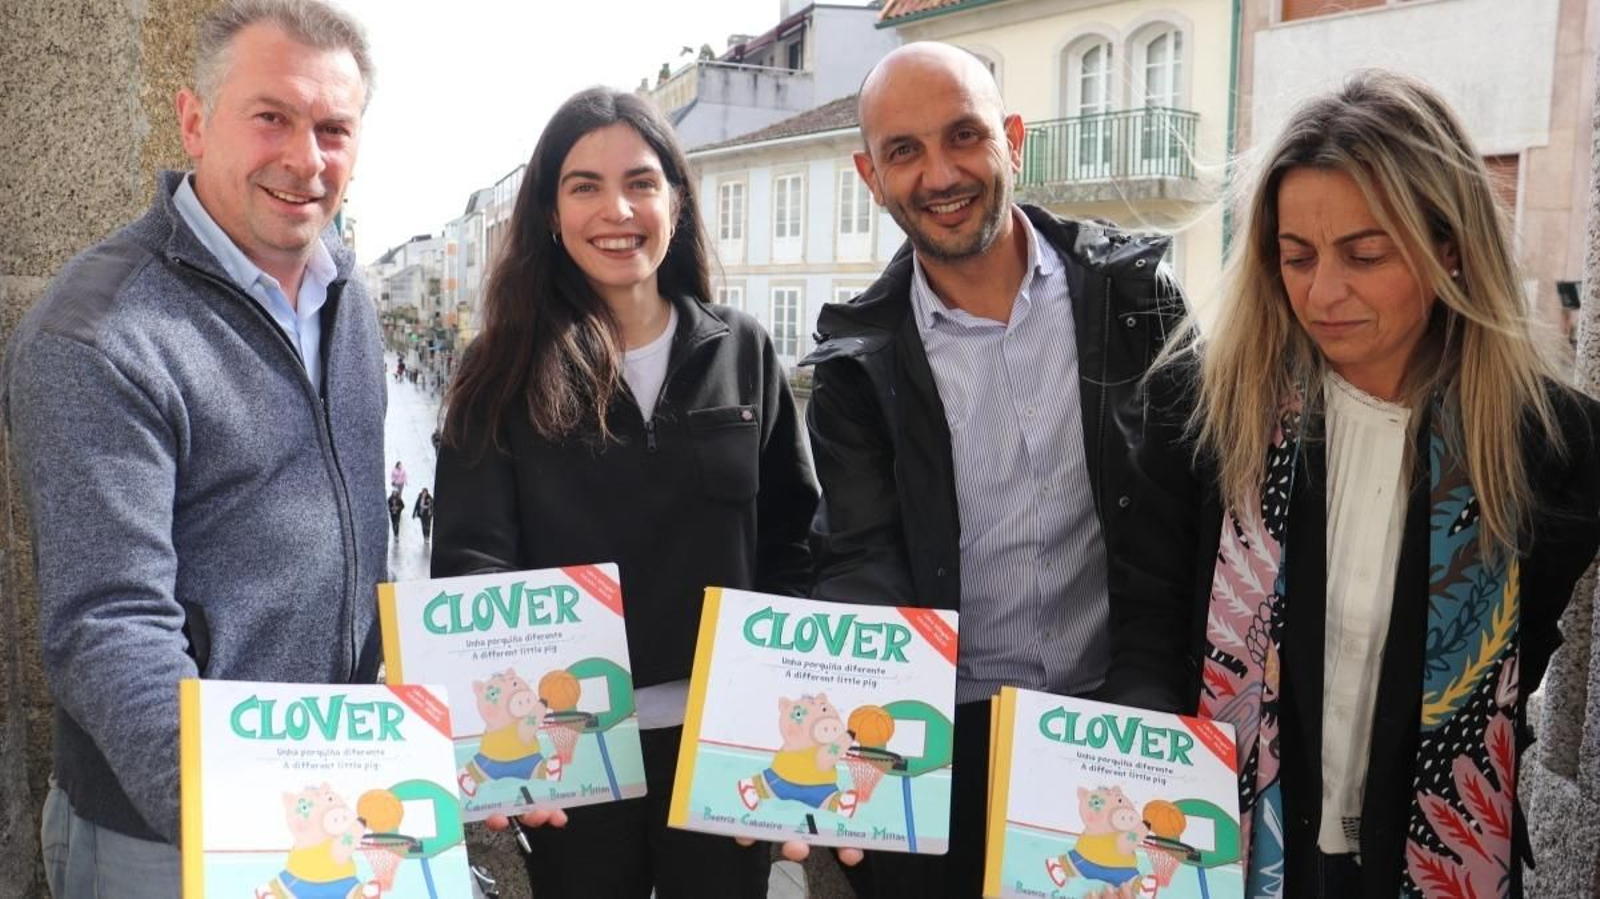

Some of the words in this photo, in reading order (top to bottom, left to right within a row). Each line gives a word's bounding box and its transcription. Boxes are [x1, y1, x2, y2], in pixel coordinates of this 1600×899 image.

[423, 581, 582, 635] CLOVER
[466, 639, 486, 648] Unha
[525, 632, 562, 642] diferente
[743, 606, 911, 663] CLOVER
[472, 651, 478, 660] A
[480, 649, 518, 659] different
[520, 646, 542, 656] little
[544, 645, 557, 655] pig
[782, 657, 802, 666] Unha
[844, 664, 886, 675] diferente
[785, 670, 791, 678] A
[794, 671, 834, 683] different
[837, 675, 861, 685] little
[863, 678, 877, 689] pig
[230, 694, 406, 741] CLOVER
[1039, 705, 1194, 766] CLOVER
[292, 761, 335, 769] different
[337, 761, 362, 769] little
[364, 762, 379, 771] pig
[1076, 751, 1096, 761] Unha
[1135, 761, 1174, 774] diferente
[1081, 763, 1087, 771] A
[1088, 764, 1126, 777] different
[1129, 771, 1151, 781] little
[1153, 776, 1166, 786] pig
